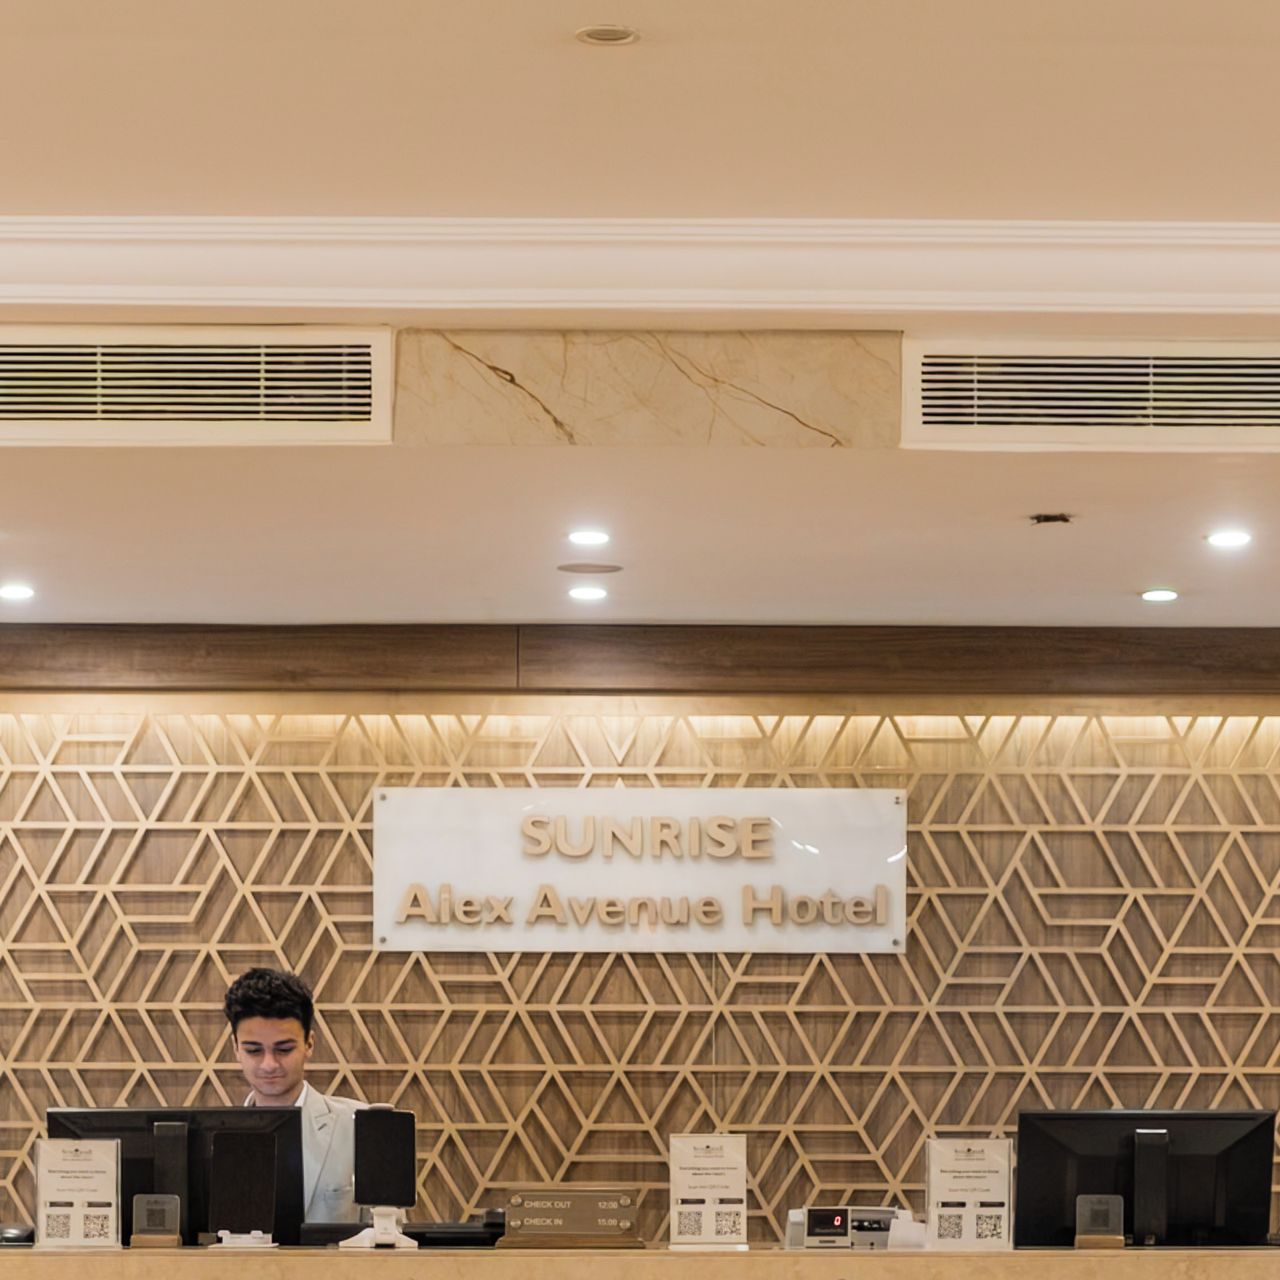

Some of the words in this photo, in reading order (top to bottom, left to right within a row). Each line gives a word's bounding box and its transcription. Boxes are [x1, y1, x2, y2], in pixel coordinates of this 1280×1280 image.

[521, 815, 773, 858] SUNRISE
[395, 883, 514, 926] Alex
[525, 883, 724, 927] Avenue
[741, 884, 889, 927] Hotel
[524, 1201, 552, 1209] CHECK
[554, 1201, 572, 1209] OUT
[524, 1218, 552, 1226] CHECK
[553, 1218, 563, 1226] IN
[834, 1216, 841, 1226] 0
